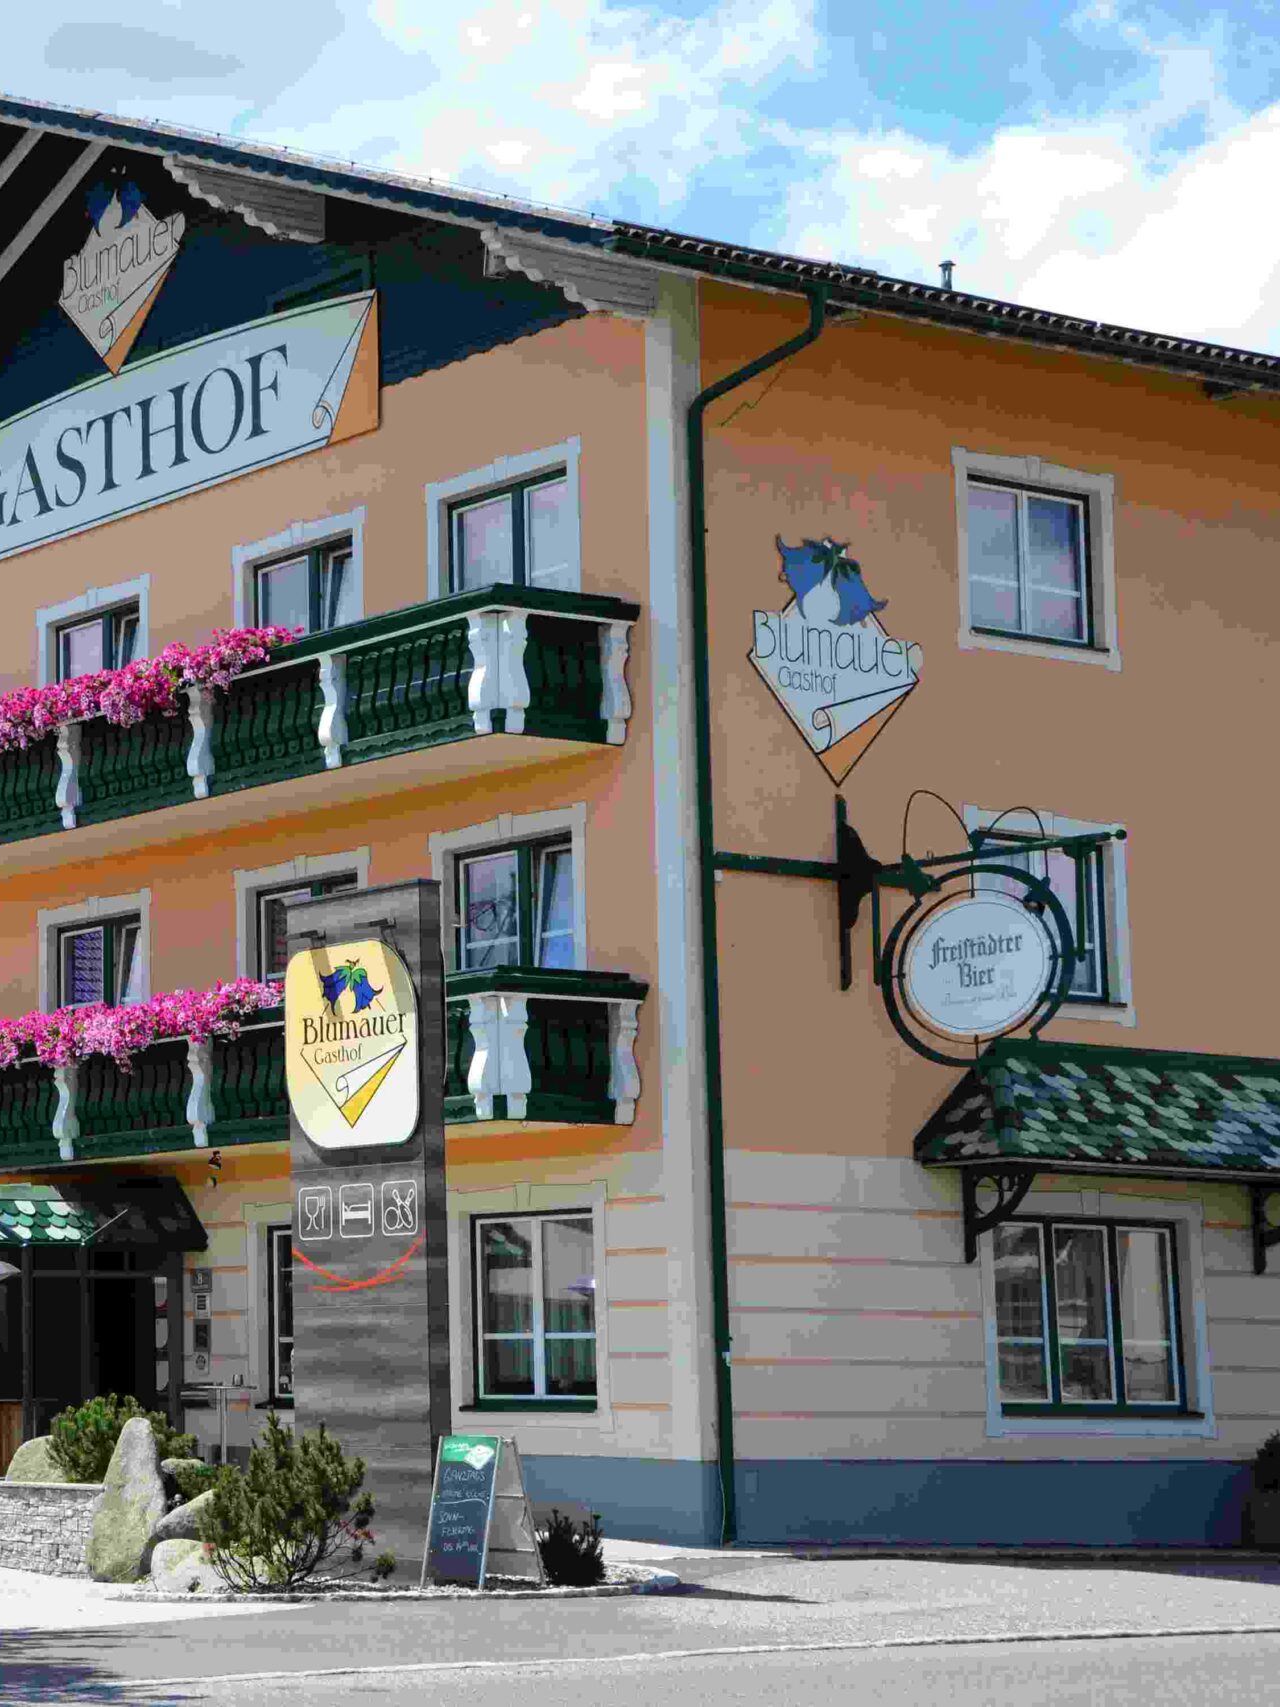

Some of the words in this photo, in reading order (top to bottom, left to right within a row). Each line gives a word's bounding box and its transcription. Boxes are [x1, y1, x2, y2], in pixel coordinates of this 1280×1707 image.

[62, 212, 183, 300] Blumauer
[753, 609, 923, 679] Blumauer
[778, 666, 837, 702] Gasthof
[957, 960, 995, 988] Bier
[302, 1013, 406, 1045] Blumauer
[314, 1043, 362, 1065] Gasthof
